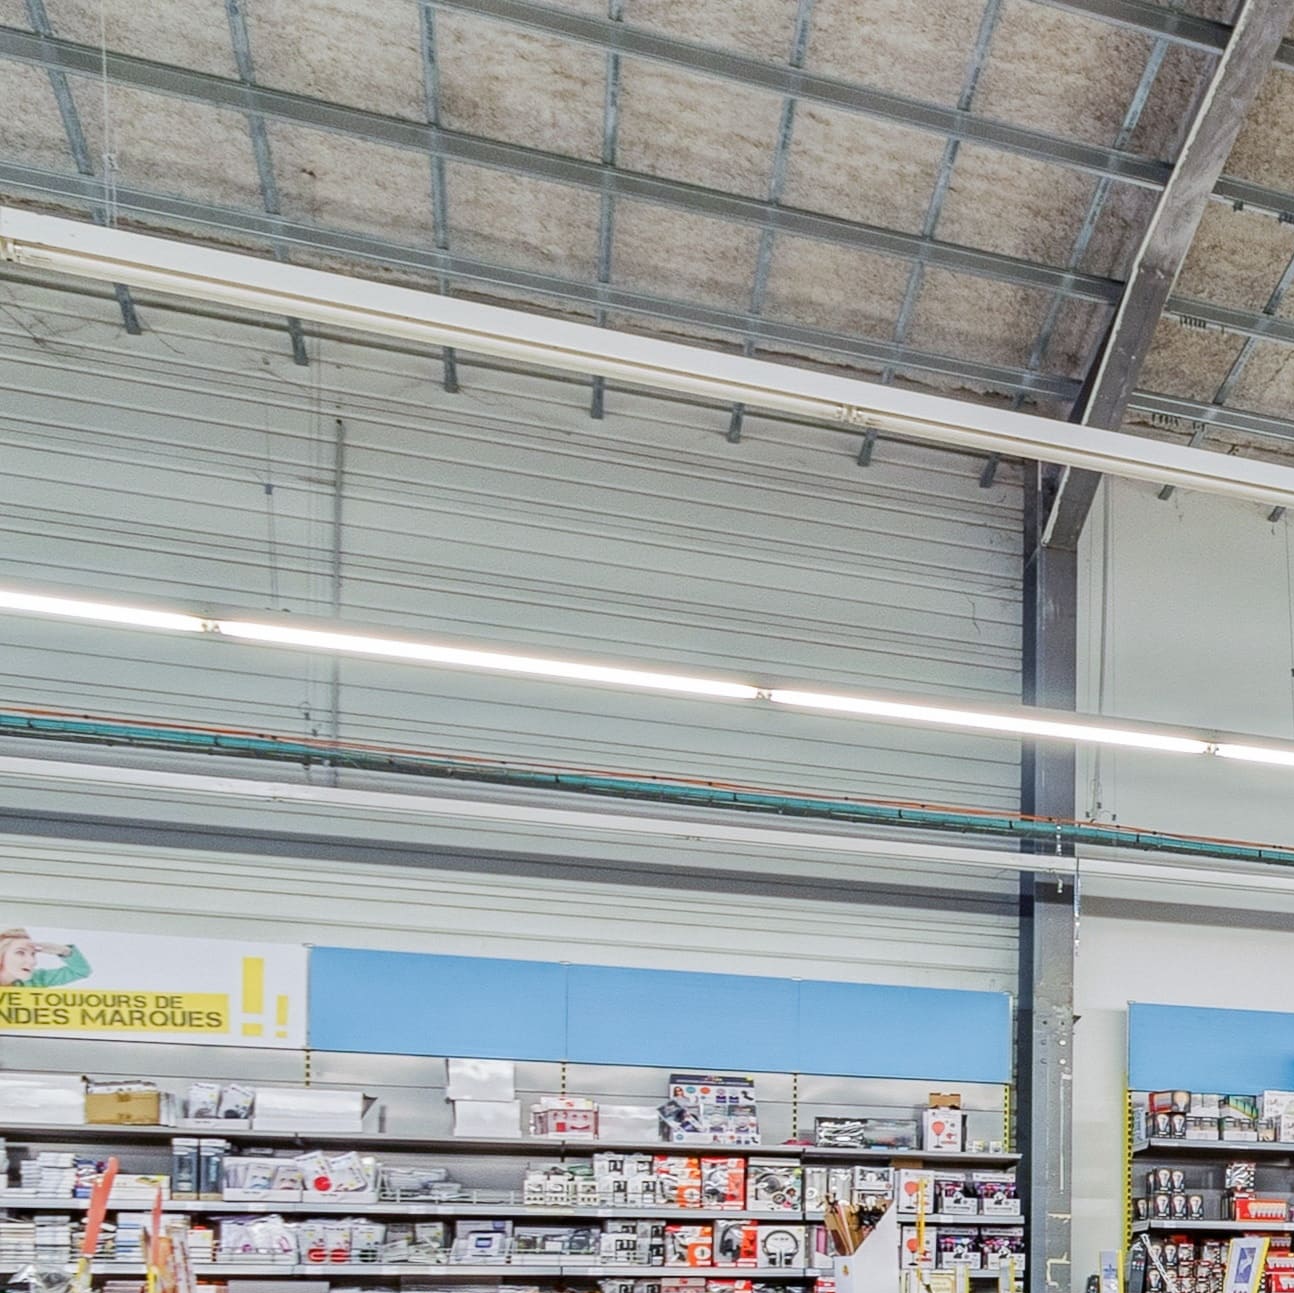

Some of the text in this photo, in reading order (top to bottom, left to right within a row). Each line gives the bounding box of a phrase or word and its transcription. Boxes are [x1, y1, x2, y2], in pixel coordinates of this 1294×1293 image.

[29, 992, 183, 1009] TOUJOURS DE
[80, 1009, 222, 1028] MARQUES
